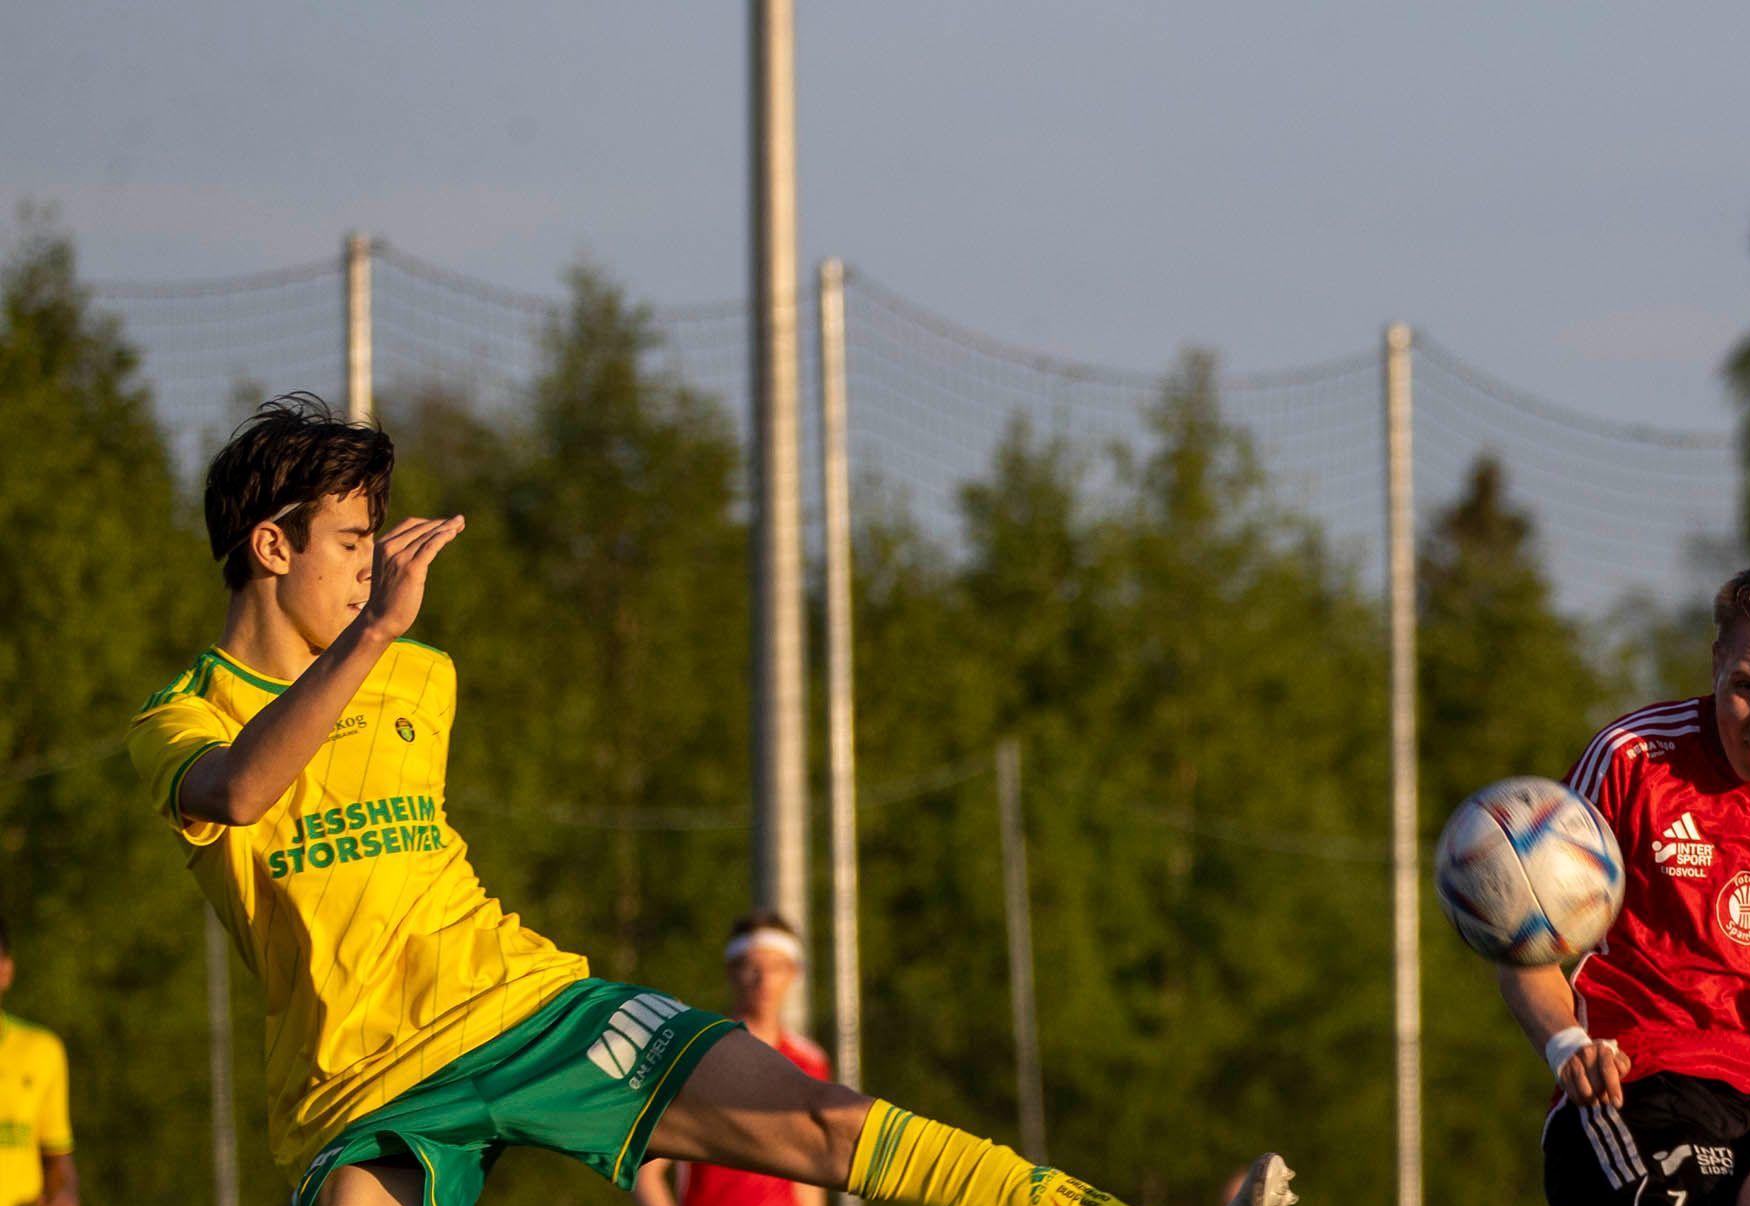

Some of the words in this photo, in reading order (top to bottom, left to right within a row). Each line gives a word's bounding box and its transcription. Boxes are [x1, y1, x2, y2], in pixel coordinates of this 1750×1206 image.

[291, 795, 436, 845] JESSHEIM
[268, 823, 449, 880] STORSENTER
[1676, 854, 1712, 867] SPORT
[1677, 843, 1713, 856] INTER
